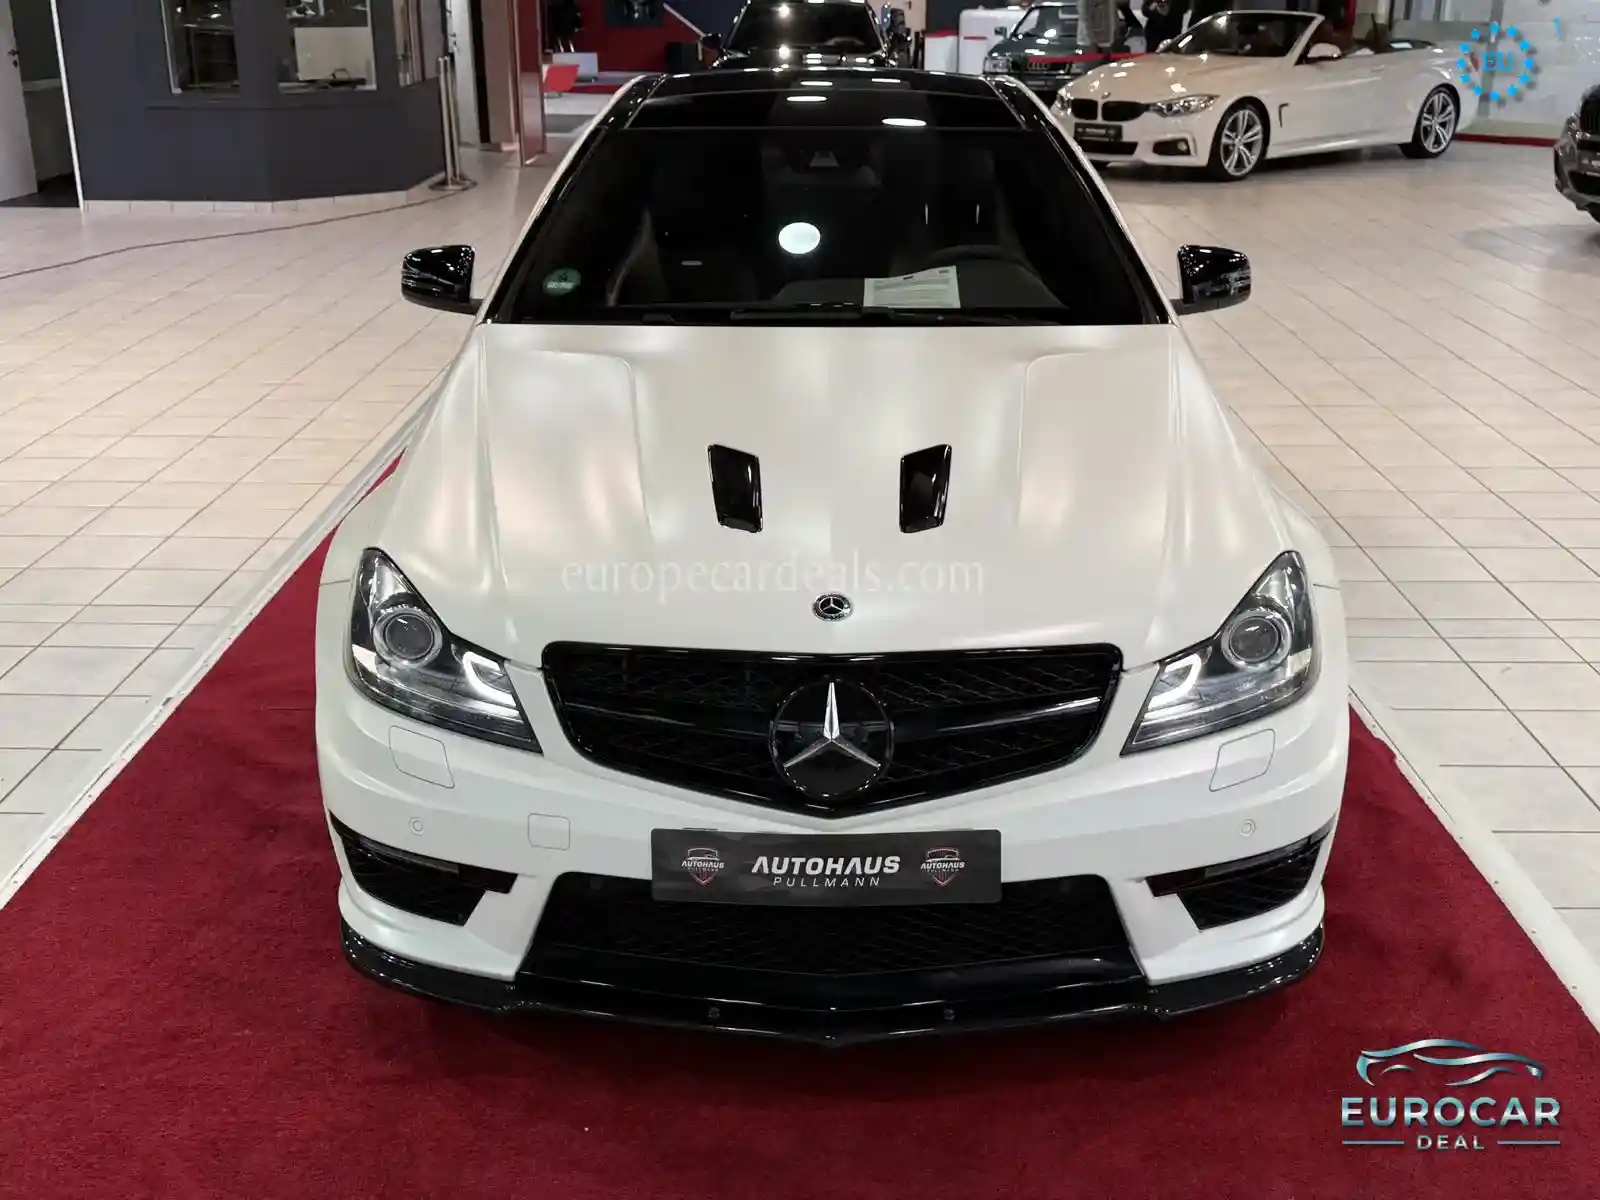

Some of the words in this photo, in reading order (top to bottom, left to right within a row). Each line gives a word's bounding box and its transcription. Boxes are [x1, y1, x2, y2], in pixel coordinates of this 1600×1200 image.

[681, 860, 725, 869] AUTOHAUS
[751, 855, 901, 875] AUTOHAUS
[920, 861, 966, 870] AUTOHAUS
[773, 876, 880, 887] PULLMANN
